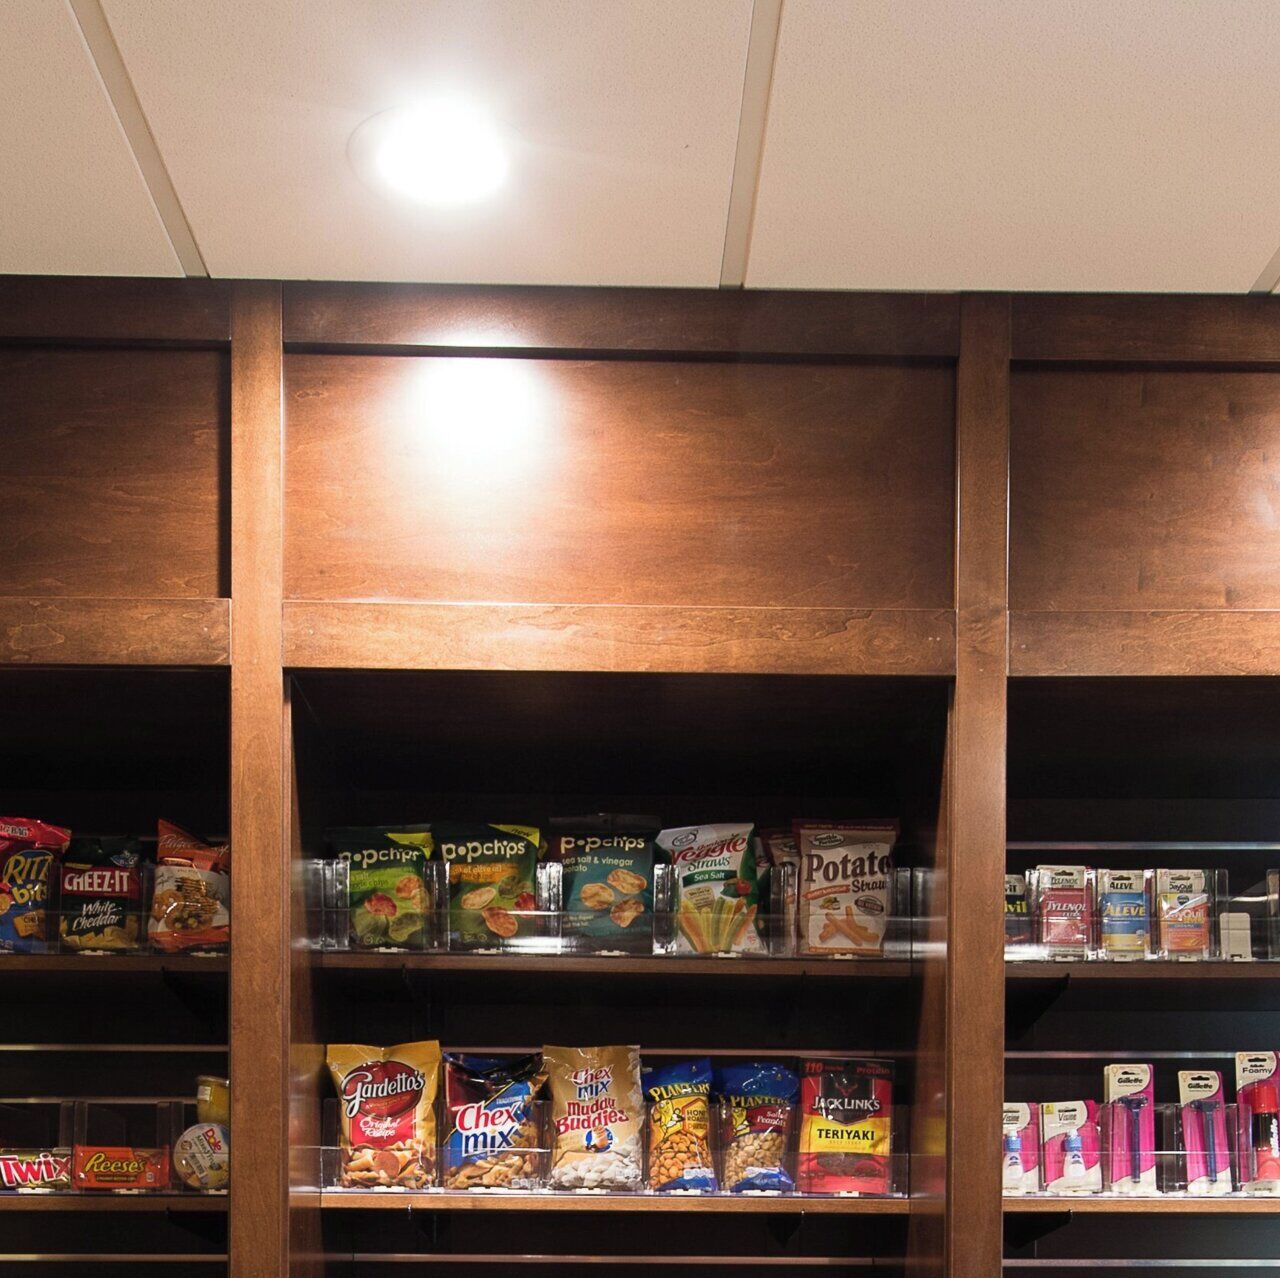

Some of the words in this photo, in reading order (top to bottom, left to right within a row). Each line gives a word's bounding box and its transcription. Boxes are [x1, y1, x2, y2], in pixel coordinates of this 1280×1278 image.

[442, 839, 527, 862] popchips
[560, 837, 646, 854] popchips
[670, 837, 747, 864] Veggie
[602, 857, 634, 867] vinegar
[687, 856, 731, 872] Straws
[804, 851, 893, 883] Potato
[694, 873, 708, 881] Sea
[711, 871, 725, 879] Salt
[1110, 882, 1134, 890] ALEVE
[82, 900, 116, 915] White
[1046, 901, 1086, 911] TYLENOL
[1103, 904, 1146, 916] ALEVE
[72, 915, 122, 932] Cheddar
[573, 1065, 614, 1085] Chex
[1242, 1066, 1272, 1074] Foamy
[341, 1070, 425, 1118] Gardetto's
[578, 1080, 610, 1099] mix
[1187, 1081, 1214, 1090] Gillette
[567, 1097, 616, 1117] Muddy
[812, 1096, 842, 1110] JACK
[359, 1116, 401, 1129] Original
[458, 1104, 517, 1131] Chex
[555, 1109, 629, 1138] Buddies
[202, 1126, 223, 1153] Dole
[363, 1127, 396, 1140] Recipe
[817, 1128, 875, 1140] TERIYAKI
[464, 1131, 516, 1155] mix
[81, 1152, 147, 1173] Reese's
